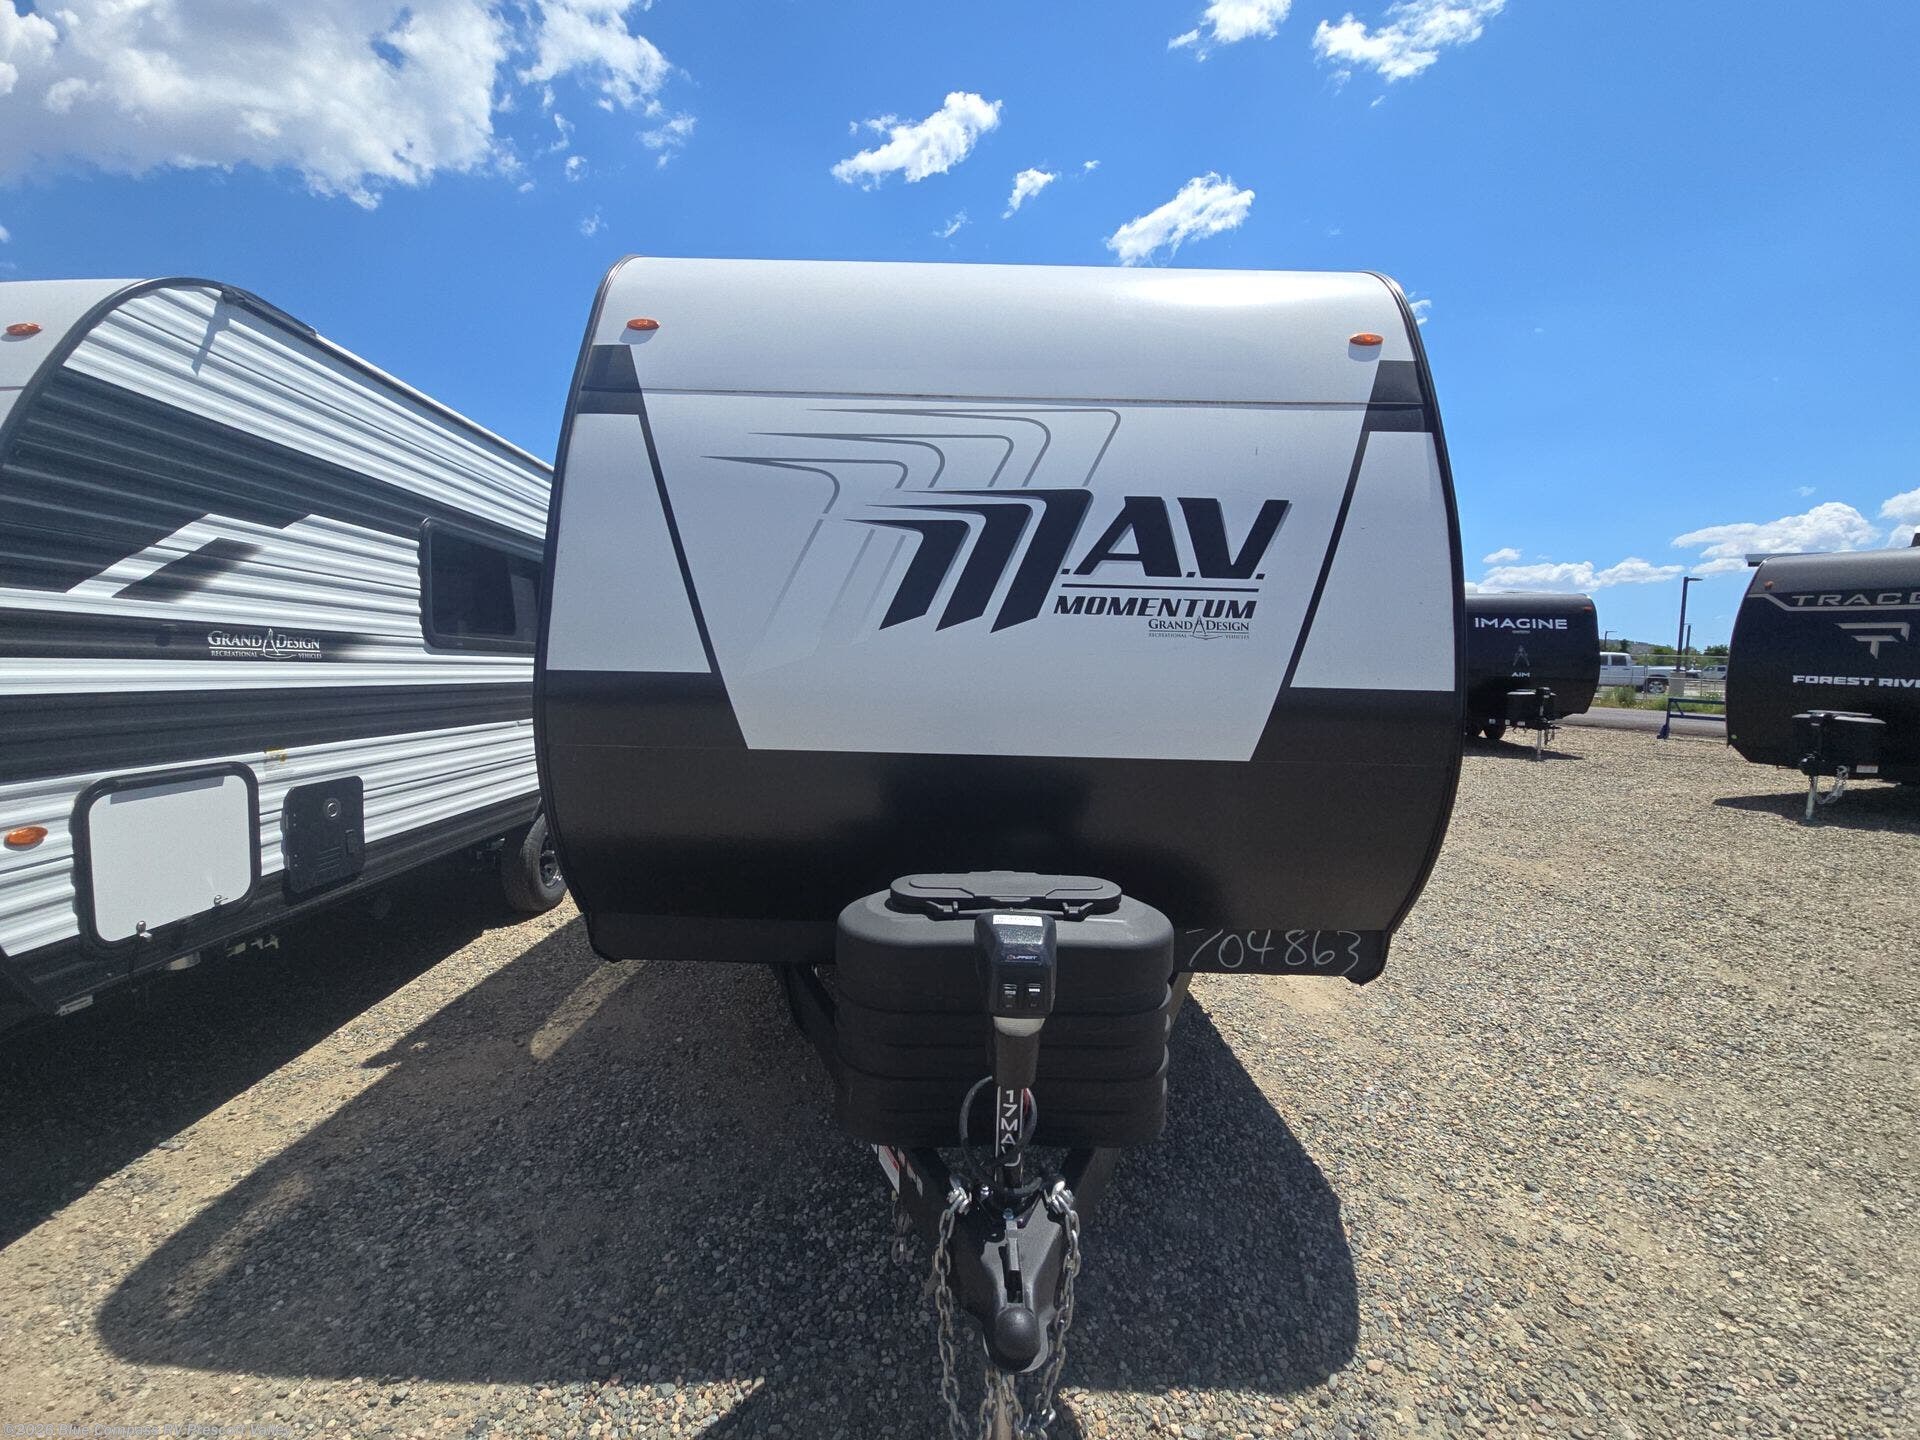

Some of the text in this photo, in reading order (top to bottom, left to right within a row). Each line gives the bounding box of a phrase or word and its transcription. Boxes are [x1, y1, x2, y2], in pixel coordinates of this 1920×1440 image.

[1053, 595, 1257, 619] MOMENTUM
[1148, 618, 1250, 631] GRAND DESIGN
[1474, 617, 1568, 630] IMAGINE
[207, 630, 321, 650] GRAND DESIGN
[211, 650, 259, 658] RECREATIONAL
[1792, 674, 1875, 687] FOREST
[1185, 928, 1362, 976] 704863
